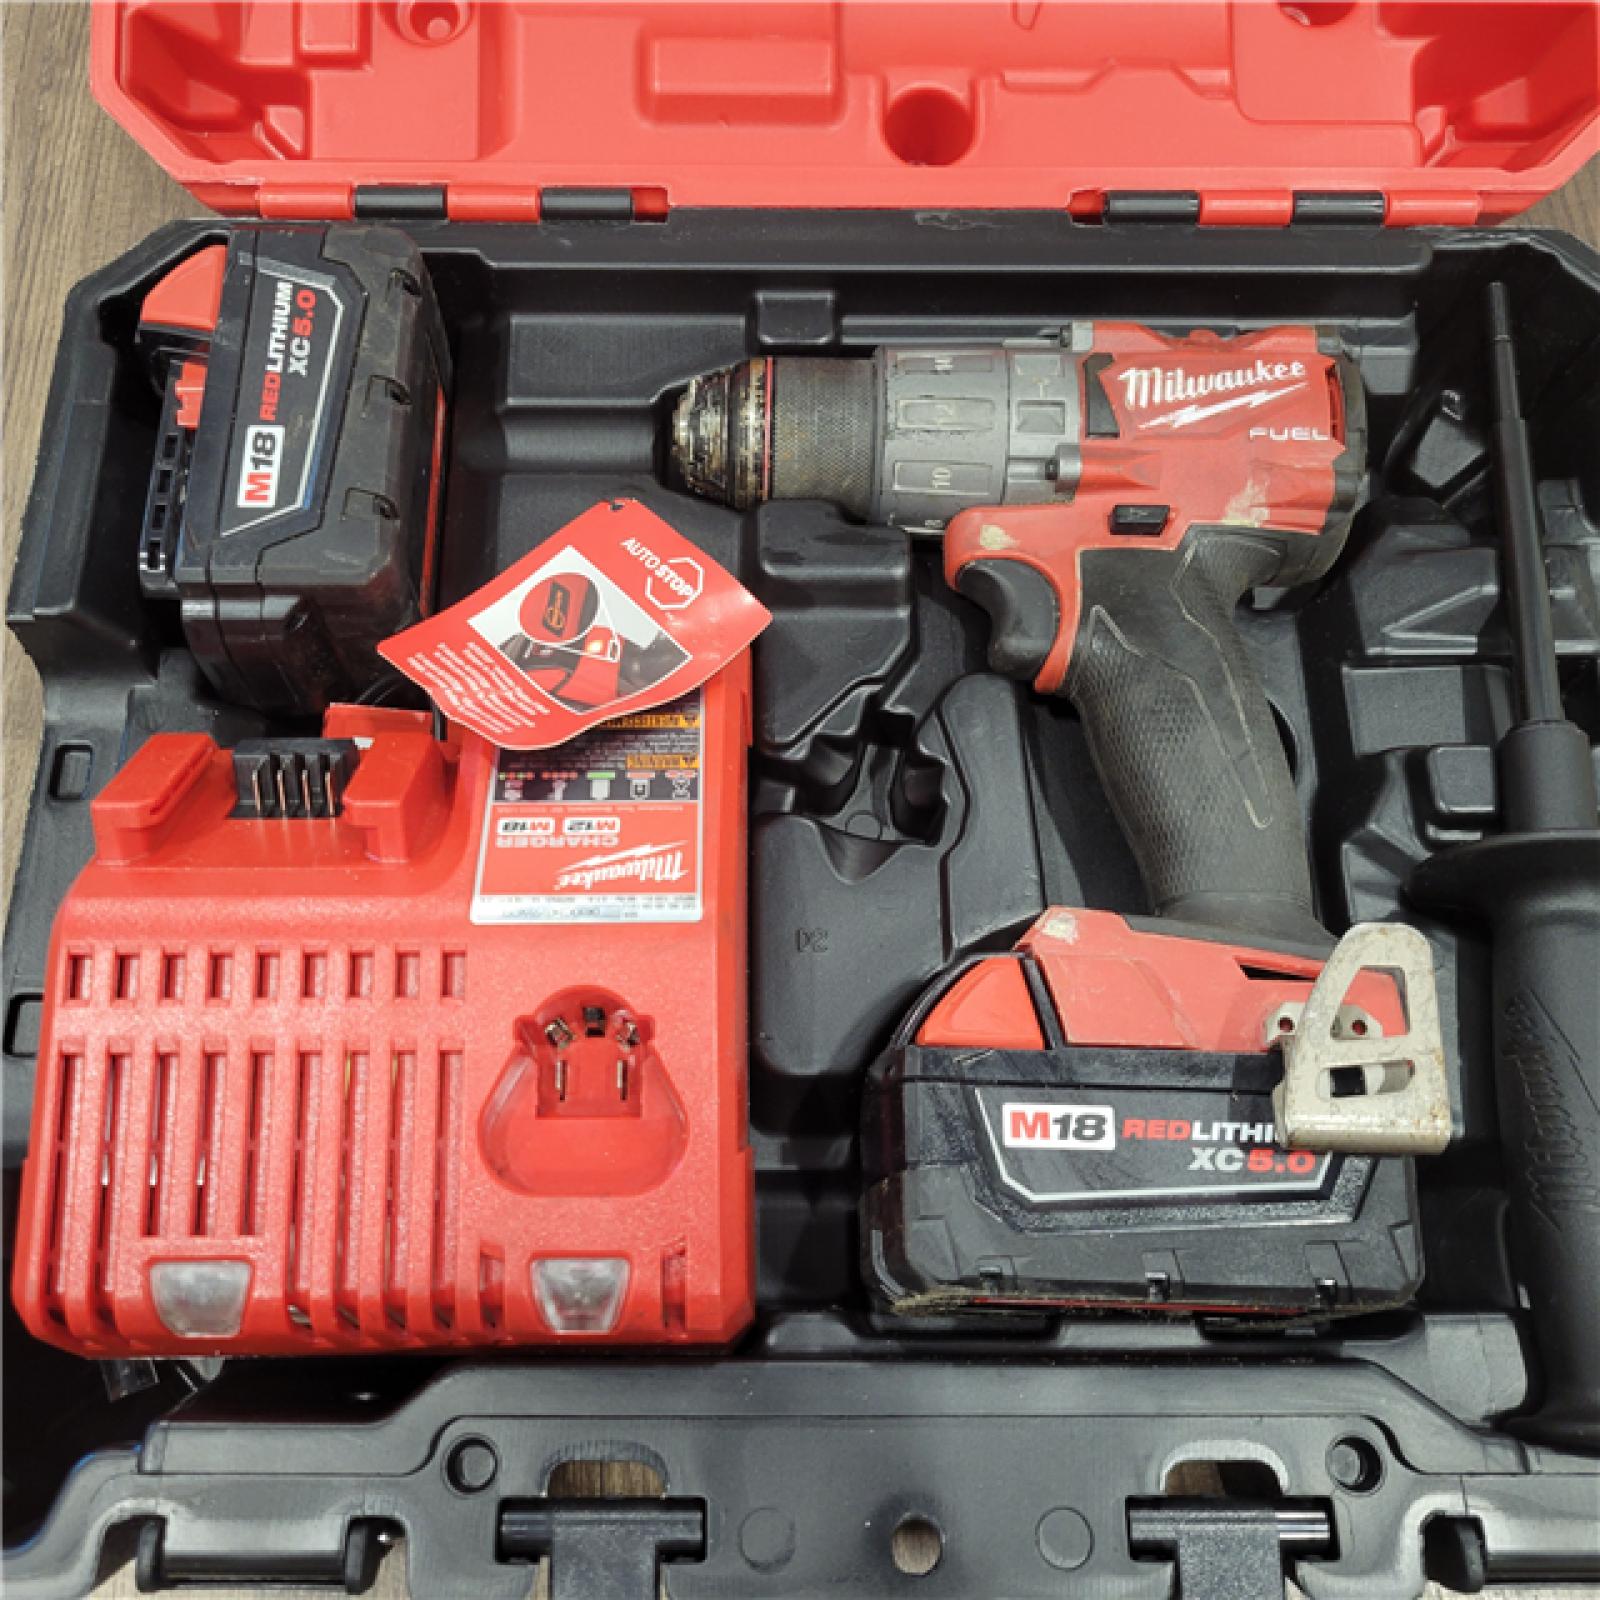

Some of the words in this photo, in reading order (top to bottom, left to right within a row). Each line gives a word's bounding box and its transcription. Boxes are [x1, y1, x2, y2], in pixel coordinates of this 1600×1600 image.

[1119, 360, 1306, 410] Milwaukee
[1249, 426, 1331, 441] FUEL
[244, 431, 278, 502] M18
[495, 835, 620, 848] CHARGER
[557, 850, 688, 890] Milwaukee
[1010, 1111, 1107, 1140] M18
[1123, 1118, 1276, 1143] REDLITHI
